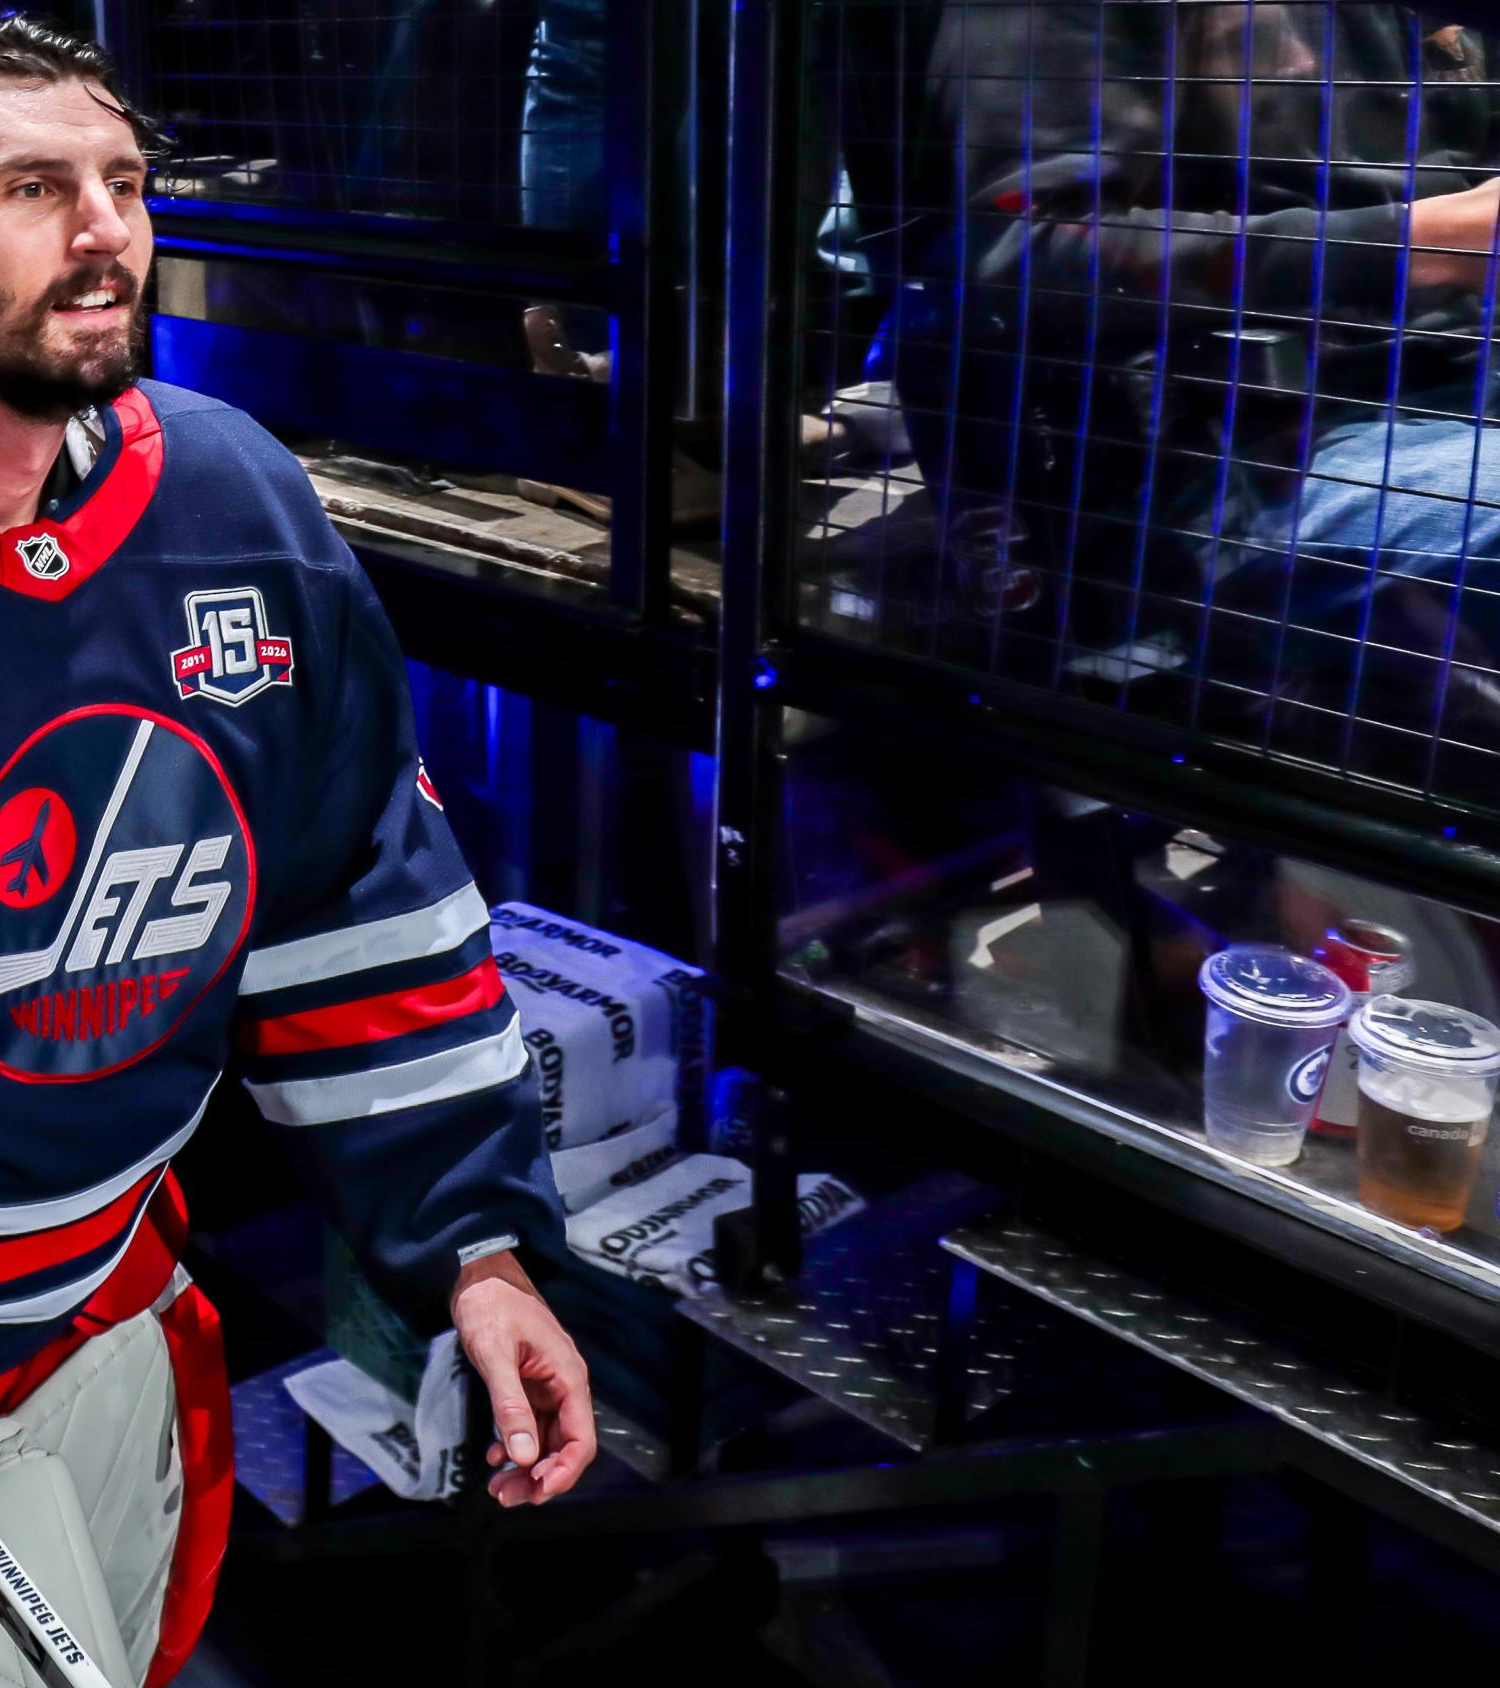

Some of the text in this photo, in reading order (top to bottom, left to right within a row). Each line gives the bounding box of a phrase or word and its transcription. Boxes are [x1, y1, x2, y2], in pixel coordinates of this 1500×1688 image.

[34, 545, 54, 572] NHL
[202, 607, 257, 678] 15
[260, 645, 287, 657] 2026
[181, 653, 206, 670] 2011
[9, 967, 192, 1041] WINNIPEG
[495, 951, 634, 1064] BODYARMOR
[1406, 1125, 1469, 1141] canada
[46, 1627, 84, 1665] JETS
